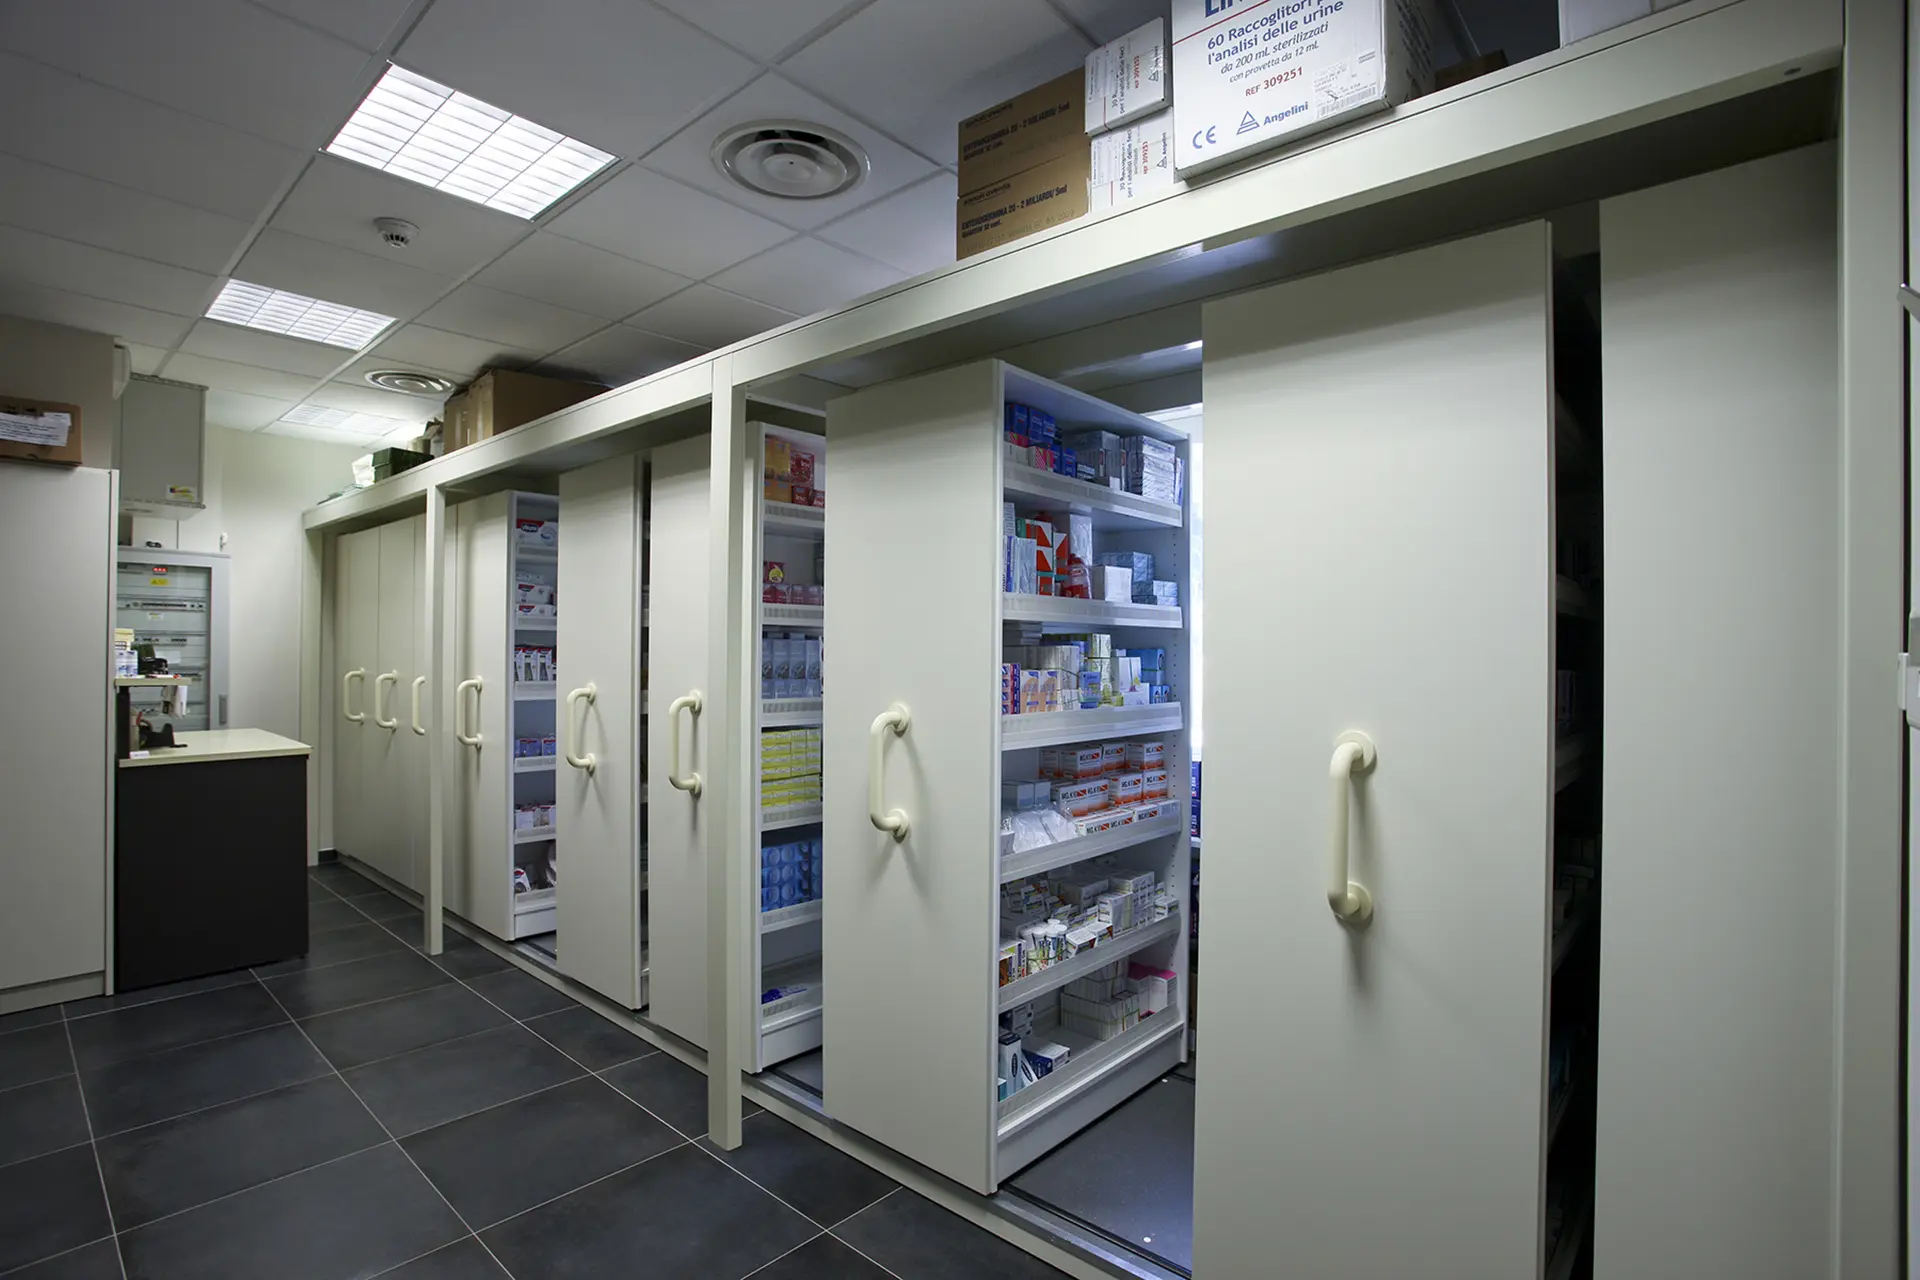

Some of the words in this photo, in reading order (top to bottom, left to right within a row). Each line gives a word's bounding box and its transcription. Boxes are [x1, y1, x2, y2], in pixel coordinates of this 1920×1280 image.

[1208, 33, 1225, 50] 60
[1229, 0, 1312, 41] Raccoglitori
[1208, 34, 1258, 65] l'analisi
[1262, 20, 1299, 42] delle
[1303, 1, 1344, 25] urine
[1220, 62, 1234, 75] da
[1235, 53, 1254, 69] 200
[1272, 21, 1329, 53] sterilizzati
[1229, 72, 1244, 83] con
[1244, 57, 1280, 79] provetta
[1281, 52, 1292, 63] da
[1295, 46, 1305, 57] 12
[1245, 84, 1261, 97] REF
[1263, 66, 1303, 90] 309251
[1263, 101, 1309, 126] Angelini
